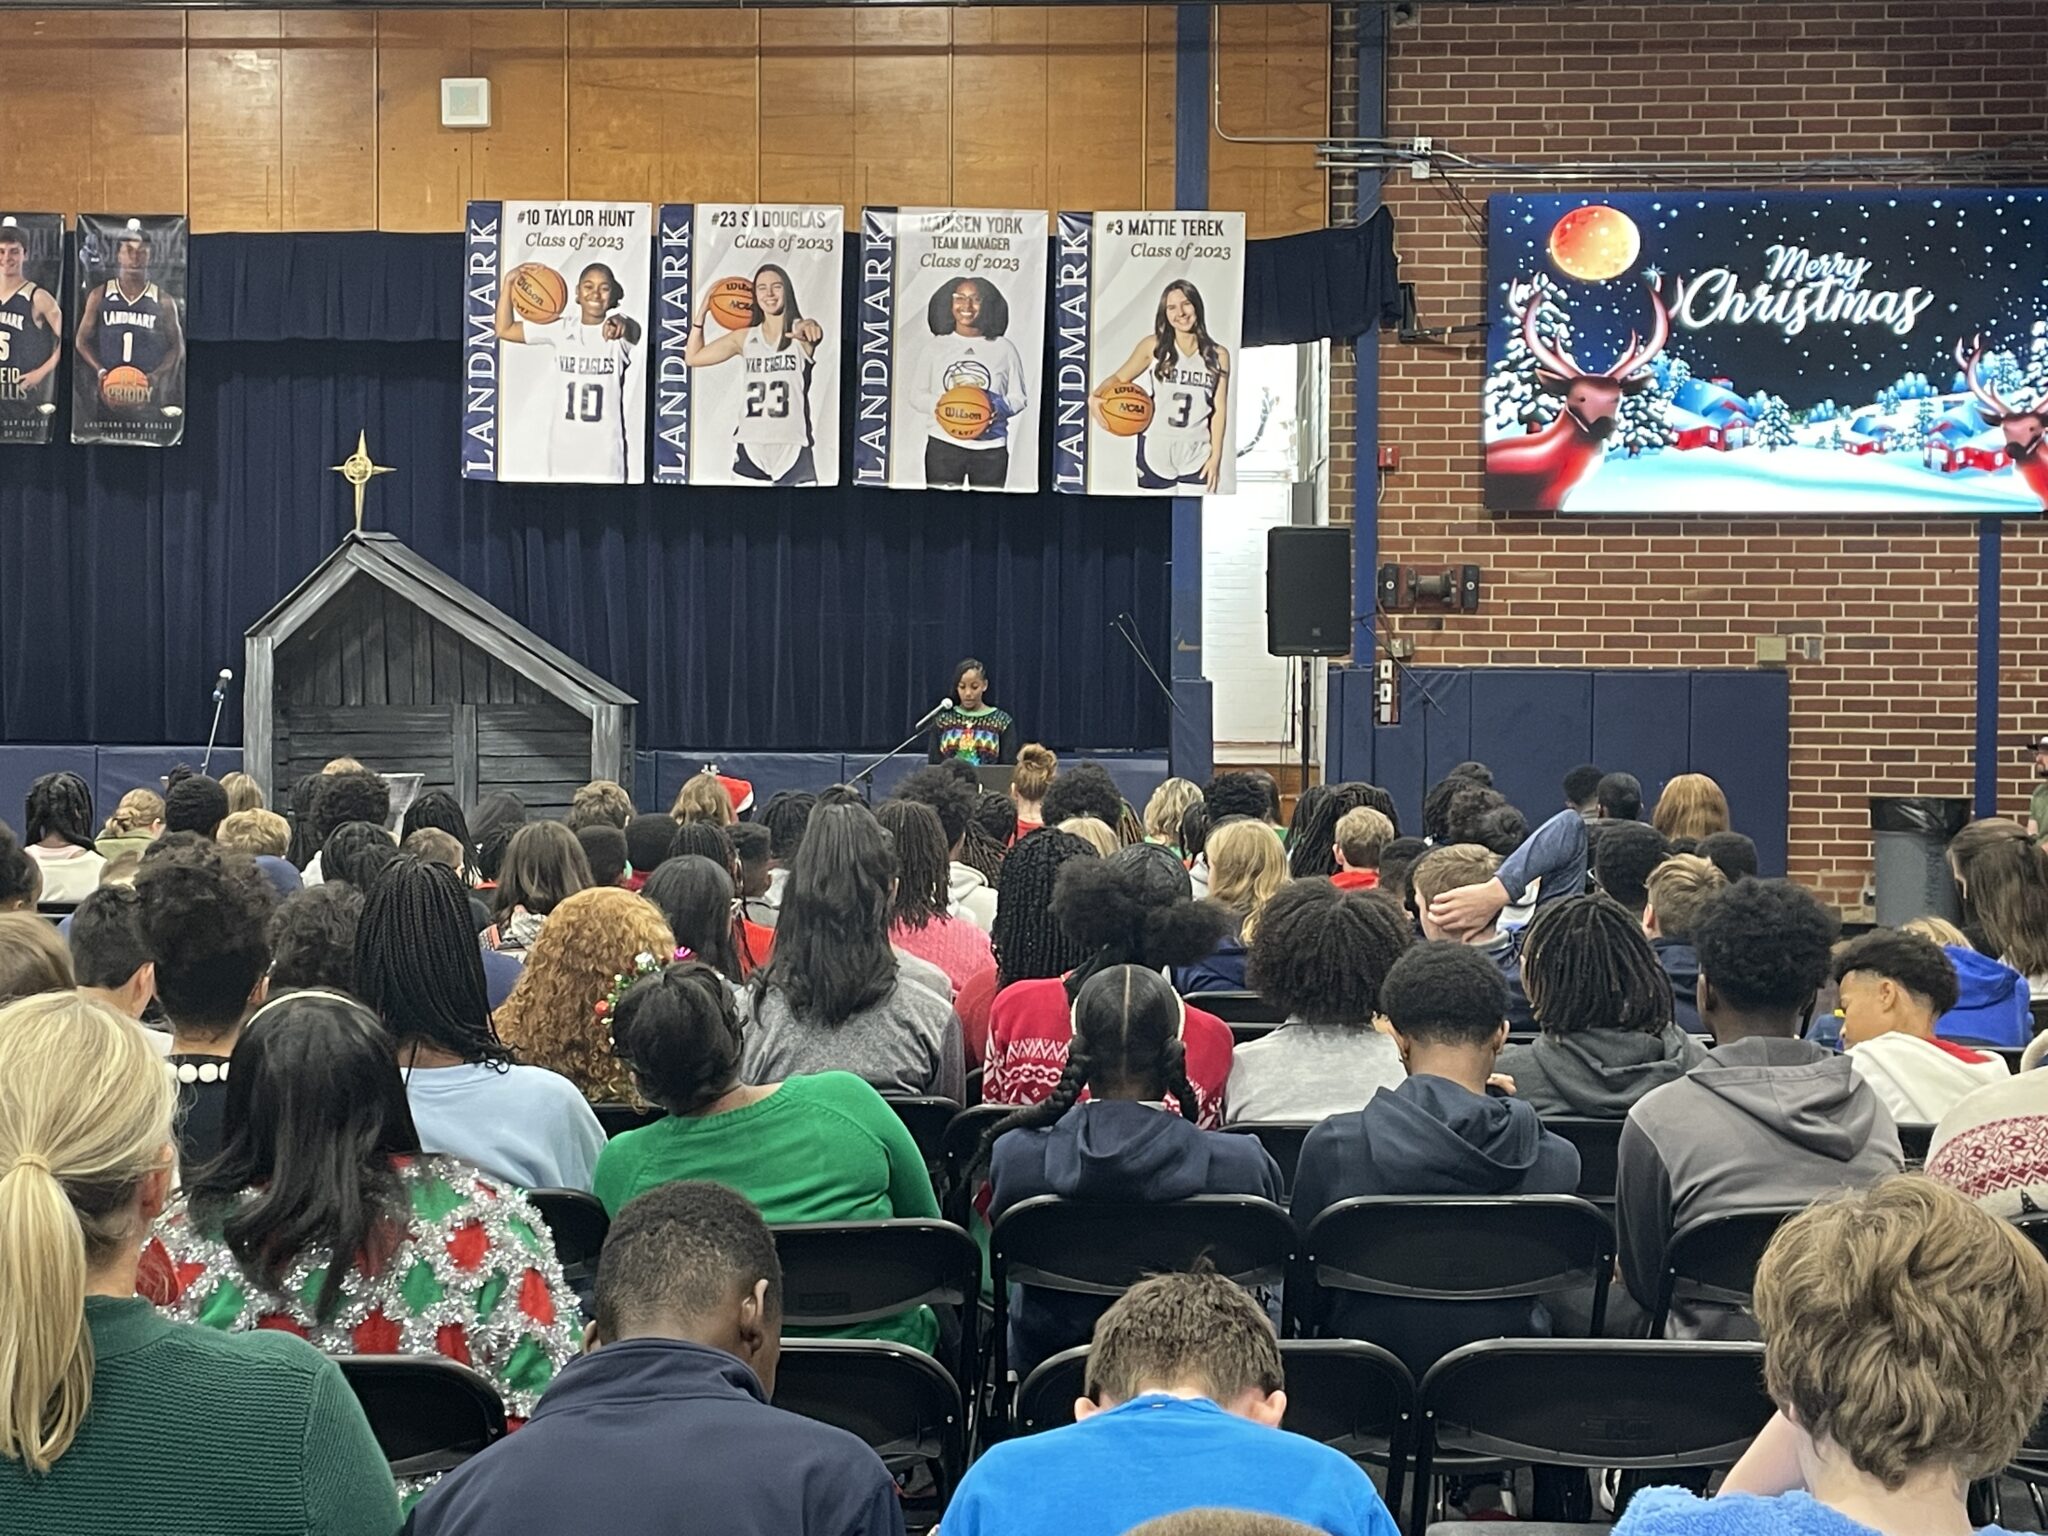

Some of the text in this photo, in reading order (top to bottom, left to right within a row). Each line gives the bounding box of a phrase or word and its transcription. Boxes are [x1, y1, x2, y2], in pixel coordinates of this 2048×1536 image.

[517, 209, 635, 227] #10 TAYLOR HUNT
[711, 211, 737, 227] #23
[762, 211, 826, 228] DOUGLAS
[986, 217, 1023, 234] YORK
[1106, 219, 1224, 236] #3 MATTIE TEREK
[525, 232, 625, 250] Class of 2023
[734, 234, 834, 252] Class of 2023
[932, 236, 1010, 251] TEAM MANAGER
[1131, 242, 1231, 261] Class of 2023
[920, 253, 1020, 272] Class of 2023
[1765, 244, 1872, 290] Merry
[1680, 265, 1935, 335] Christmas
[103, 311, 157, 329] LANDMARK
[123, 332, 134, 363] 1
[466, 217, 498, 473] LANDMARK
[659, 220, 690, 476] LANDMARK
[858, 224, 892, 480] LANDMARK
[579, 357, 614, 375] EAGLES
[764, 355, 797, 374] EAGLES
[1056, 227, 1088, 486] LANDMARK
[565, 382, 603, 422] 10
[745, 381, 790, 418] 23
[945, 407, 981, 420] Wilson
[1168, 392, 1193, 428] 3
